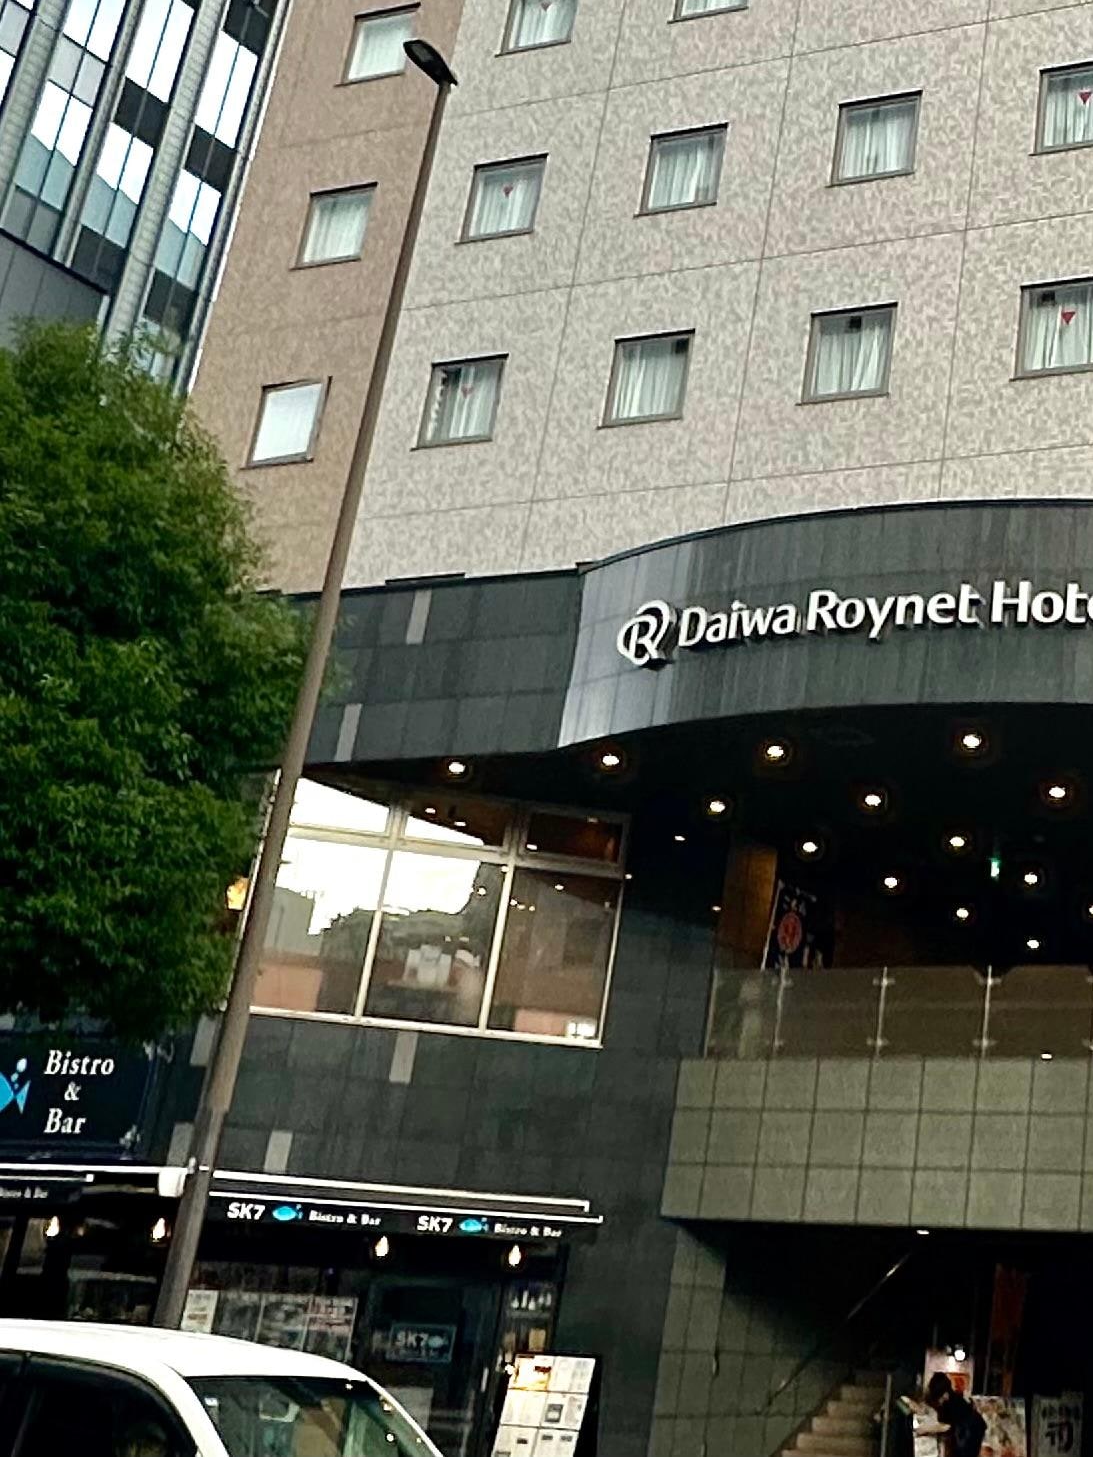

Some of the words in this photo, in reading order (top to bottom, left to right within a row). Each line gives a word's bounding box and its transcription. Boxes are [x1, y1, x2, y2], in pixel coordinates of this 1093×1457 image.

[678, 599, 799, 648] Daiwa
[806, 582, 980, 639] Roynet
[43, 1049, 115, 1075] Bistro
[63, 1081, 82, 1101] &
[43, 1107, 88, 1134] Bar
[227, 1201, 266, 1220] SK7
[417, 1215, 454, 1233] SK7
